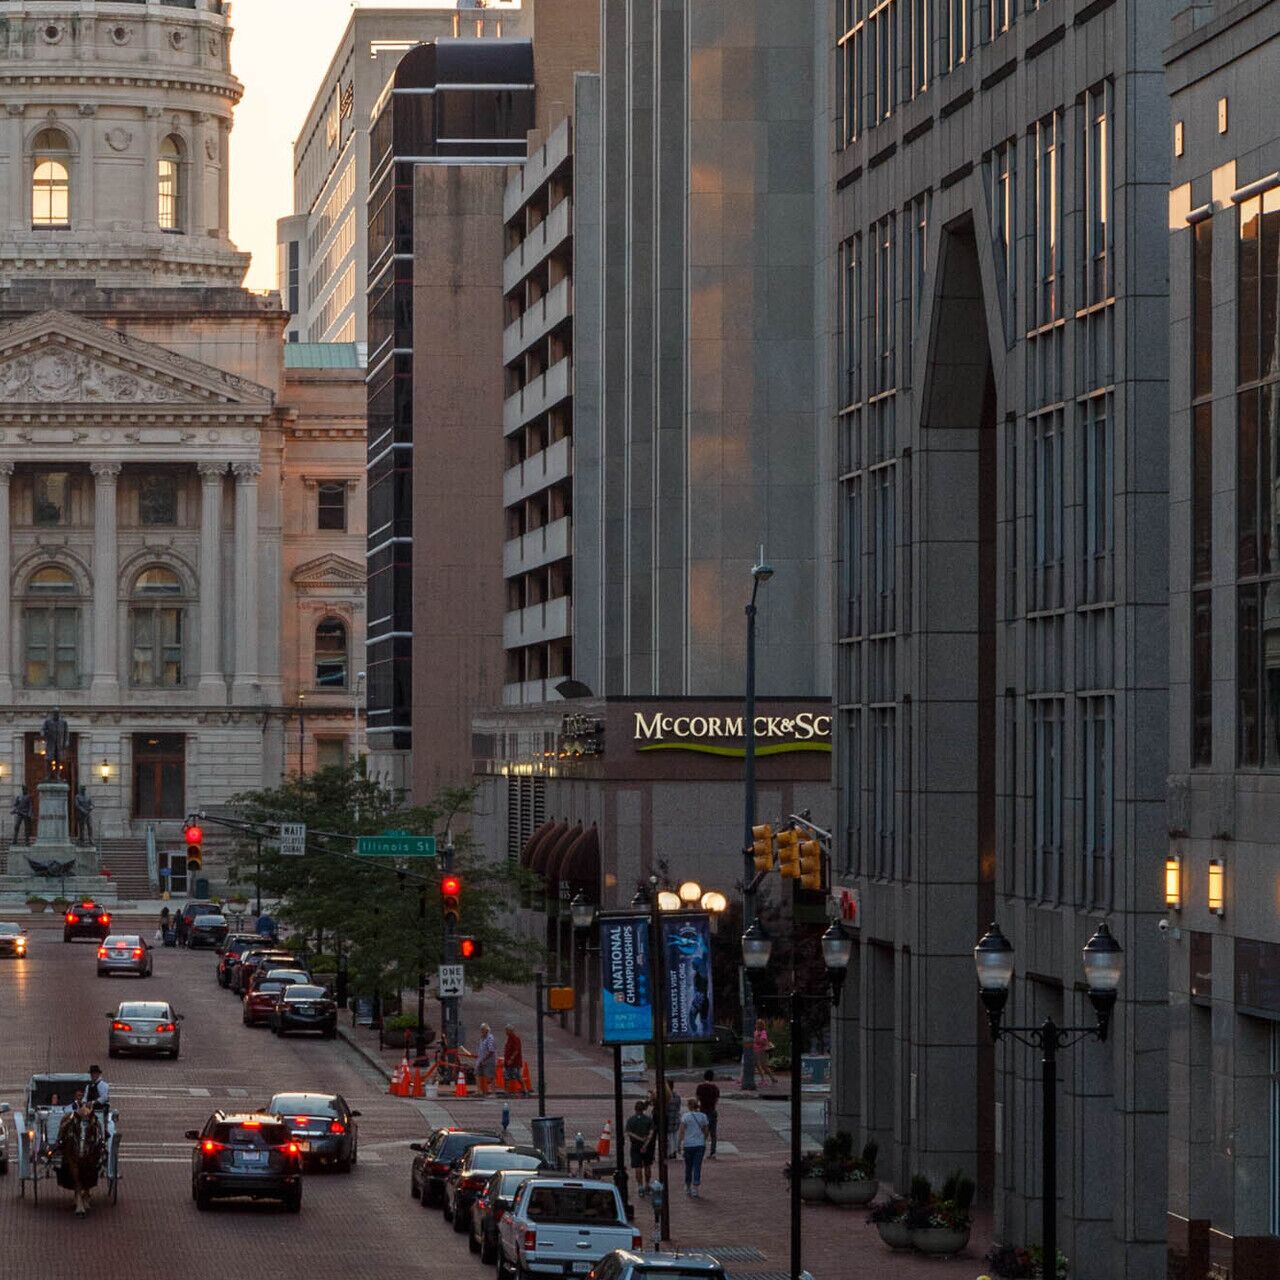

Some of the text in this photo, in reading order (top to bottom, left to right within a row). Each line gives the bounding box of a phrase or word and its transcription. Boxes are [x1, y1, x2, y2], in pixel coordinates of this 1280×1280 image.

[284, 826, 302, 835] WAIT
[362, 840, 430, 852] Illinois St
[610, 925, 625, 990] NATIONAL
[623, 925, 636, 1003] CHAMPIONSHIPS
[670, 969, 679, 1033] FOR TICKETS VISIT
